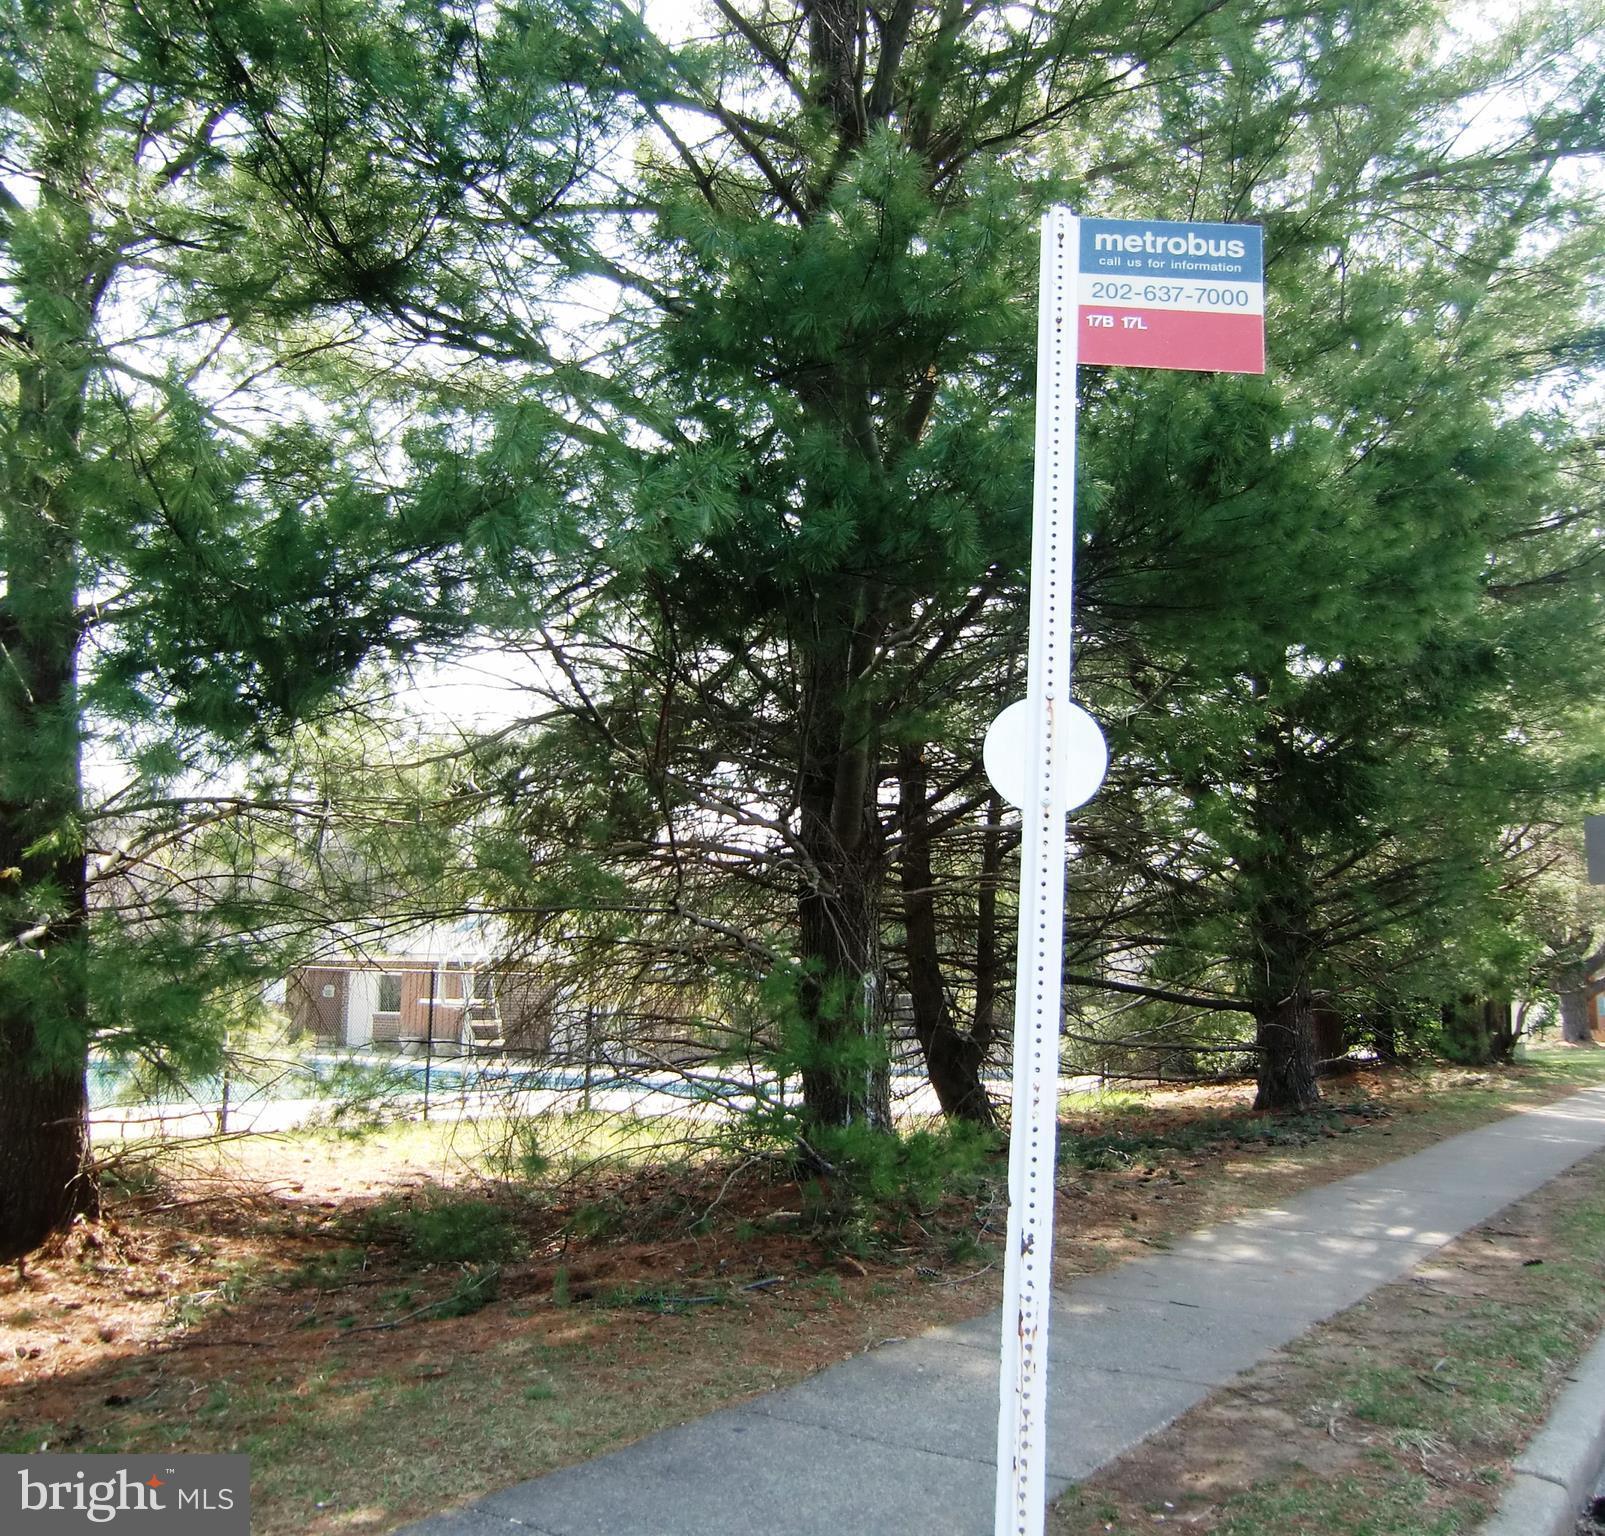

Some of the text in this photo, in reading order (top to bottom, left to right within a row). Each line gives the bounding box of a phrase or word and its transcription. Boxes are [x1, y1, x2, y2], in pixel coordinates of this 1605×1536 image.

[1095, 231, 1245, 257] metrobus
[1099, 257, 1242, 273] call us for information
[1092, 282, 1249, 307] 202-637-7000
[1086, 314, 1148, 330] 17B 17L
